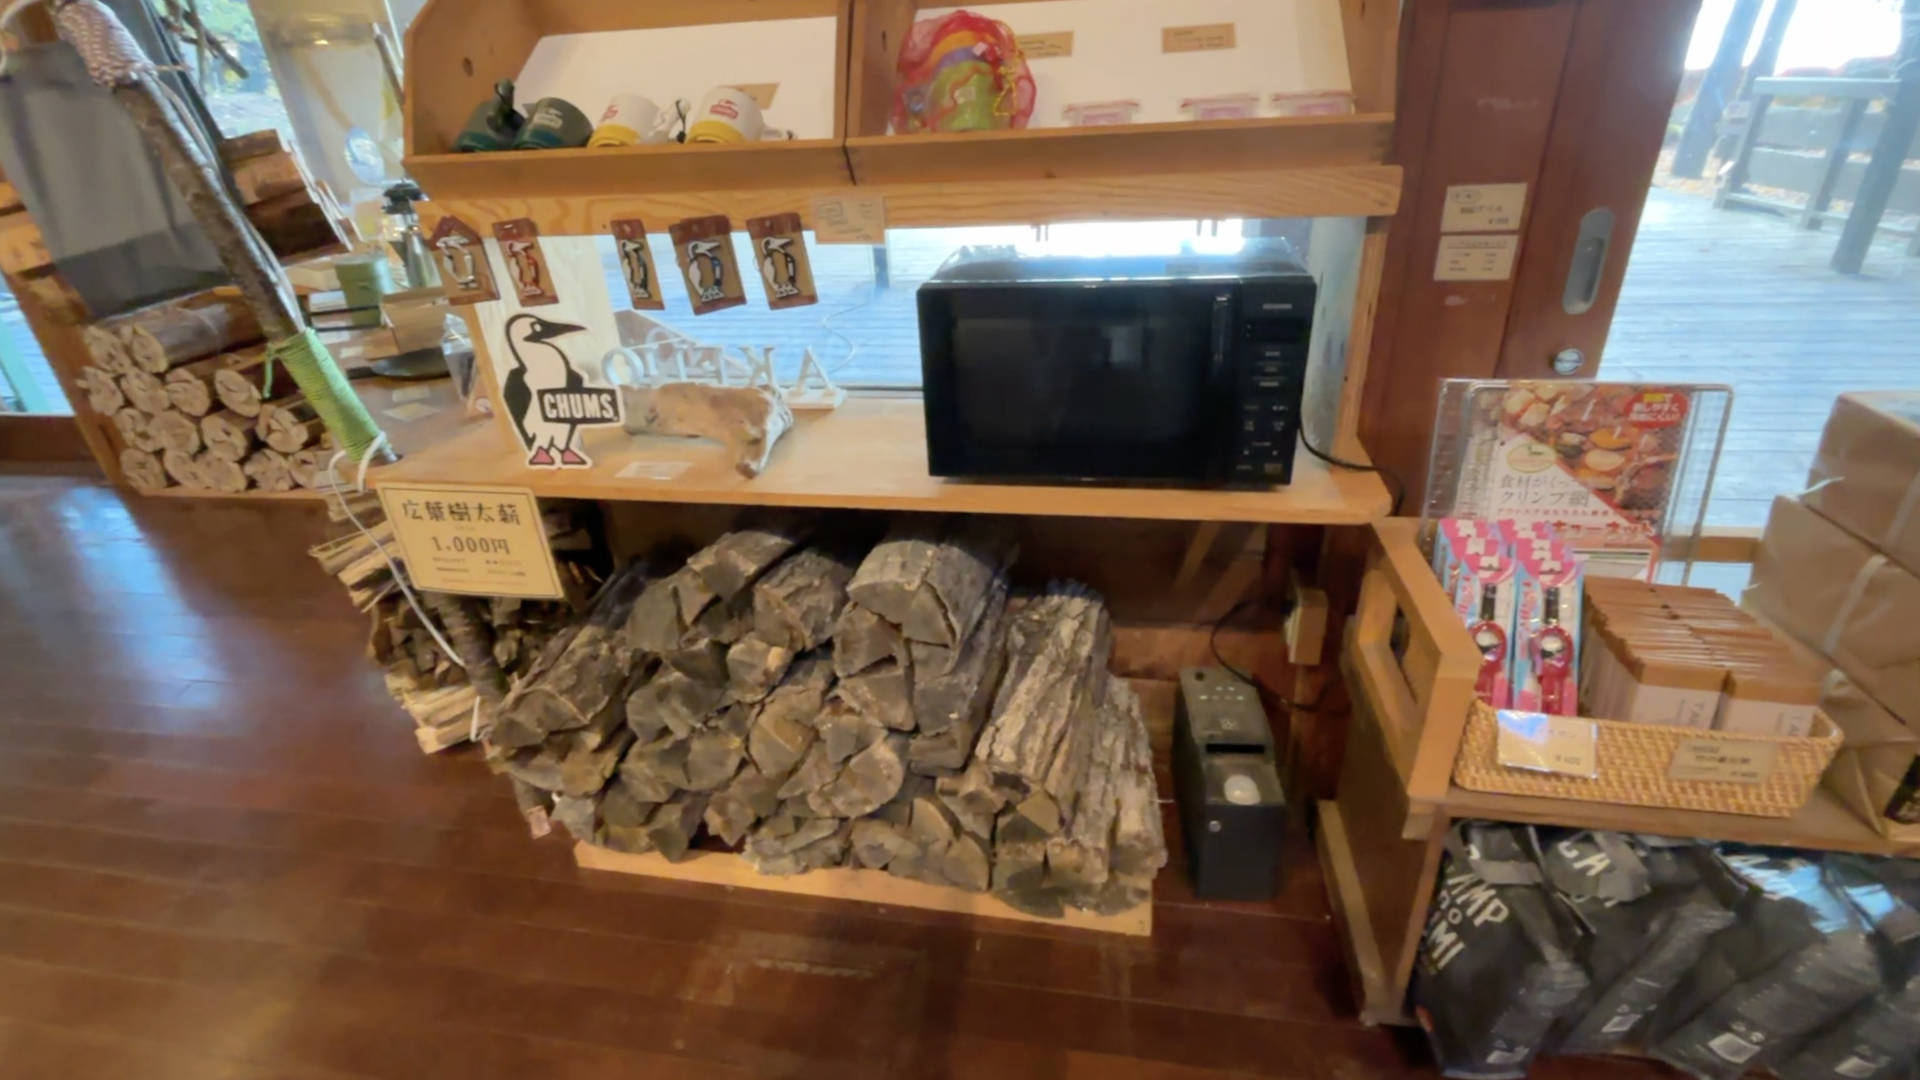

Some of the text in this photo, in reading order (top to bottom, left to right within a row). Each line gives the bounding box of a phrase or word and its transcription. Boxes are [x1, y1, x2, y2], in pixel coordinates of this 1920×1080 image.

[542, 393, 616, 421] CHUMS
[401, 499, 522, 526] 広葉樹太薪
[1446, 870, 1511, 928] AMP
